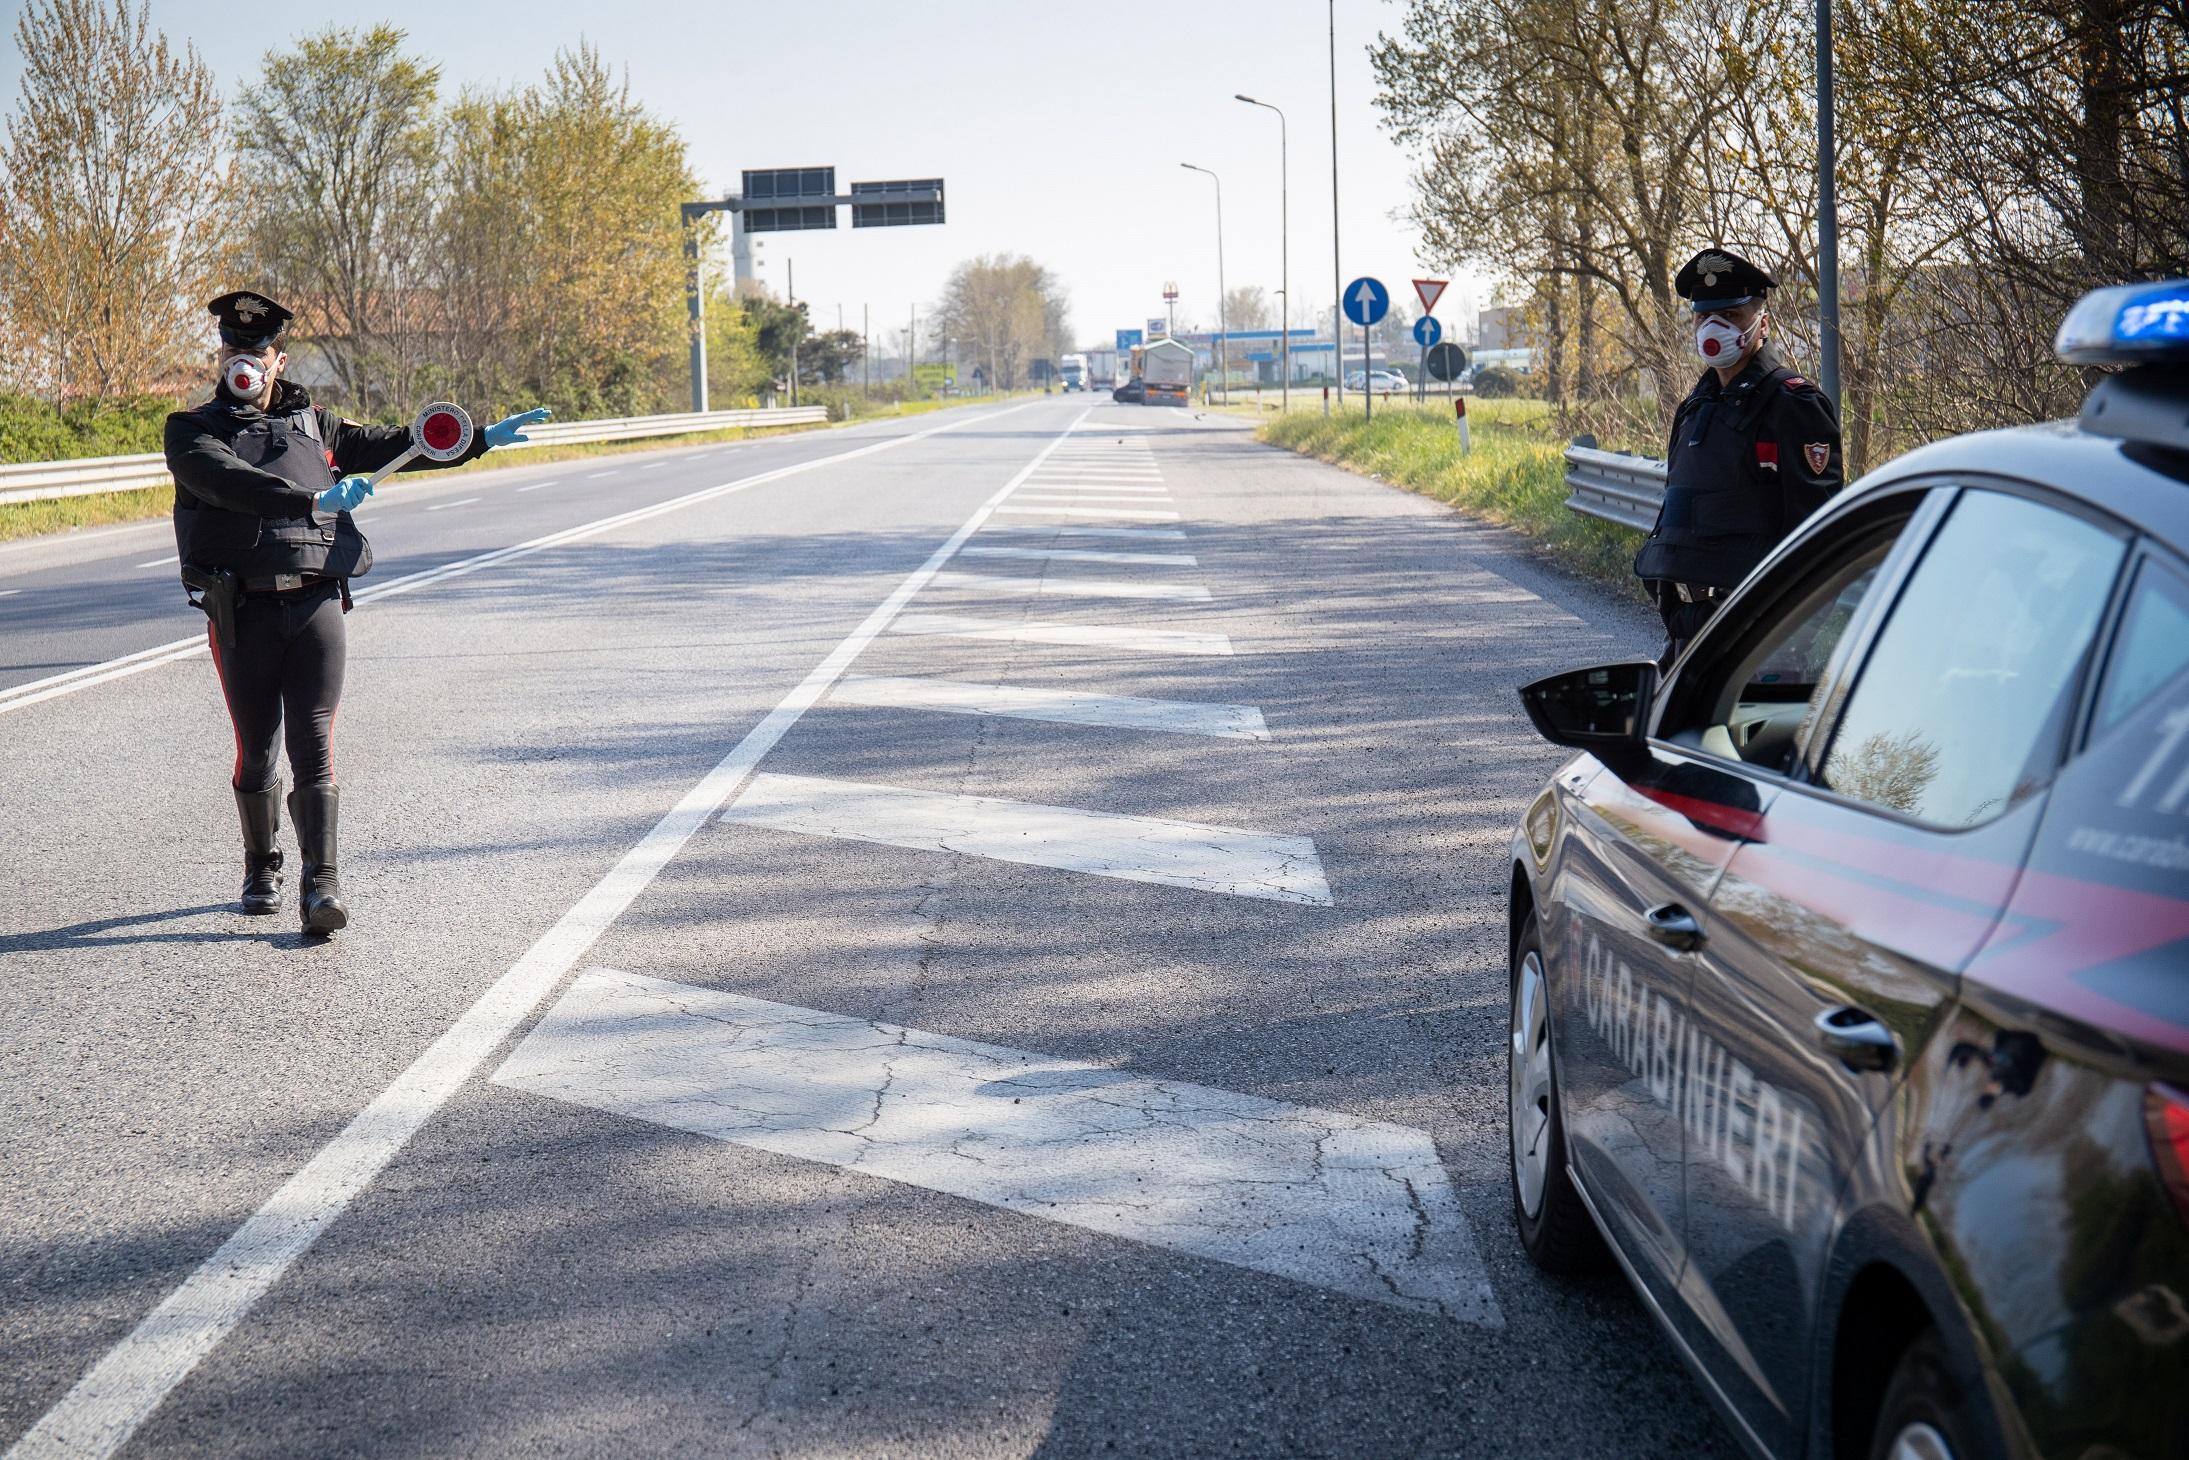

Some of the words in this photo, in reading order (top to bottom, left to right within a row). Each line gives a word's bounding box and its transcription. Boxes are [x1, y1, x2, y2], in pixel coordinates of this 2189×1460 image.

[422, 405, 460, 418] MINISTERO
[446, 439, 467, 456] DIFESA
[1587, 933, 1801, 1232] CARABINIERI
